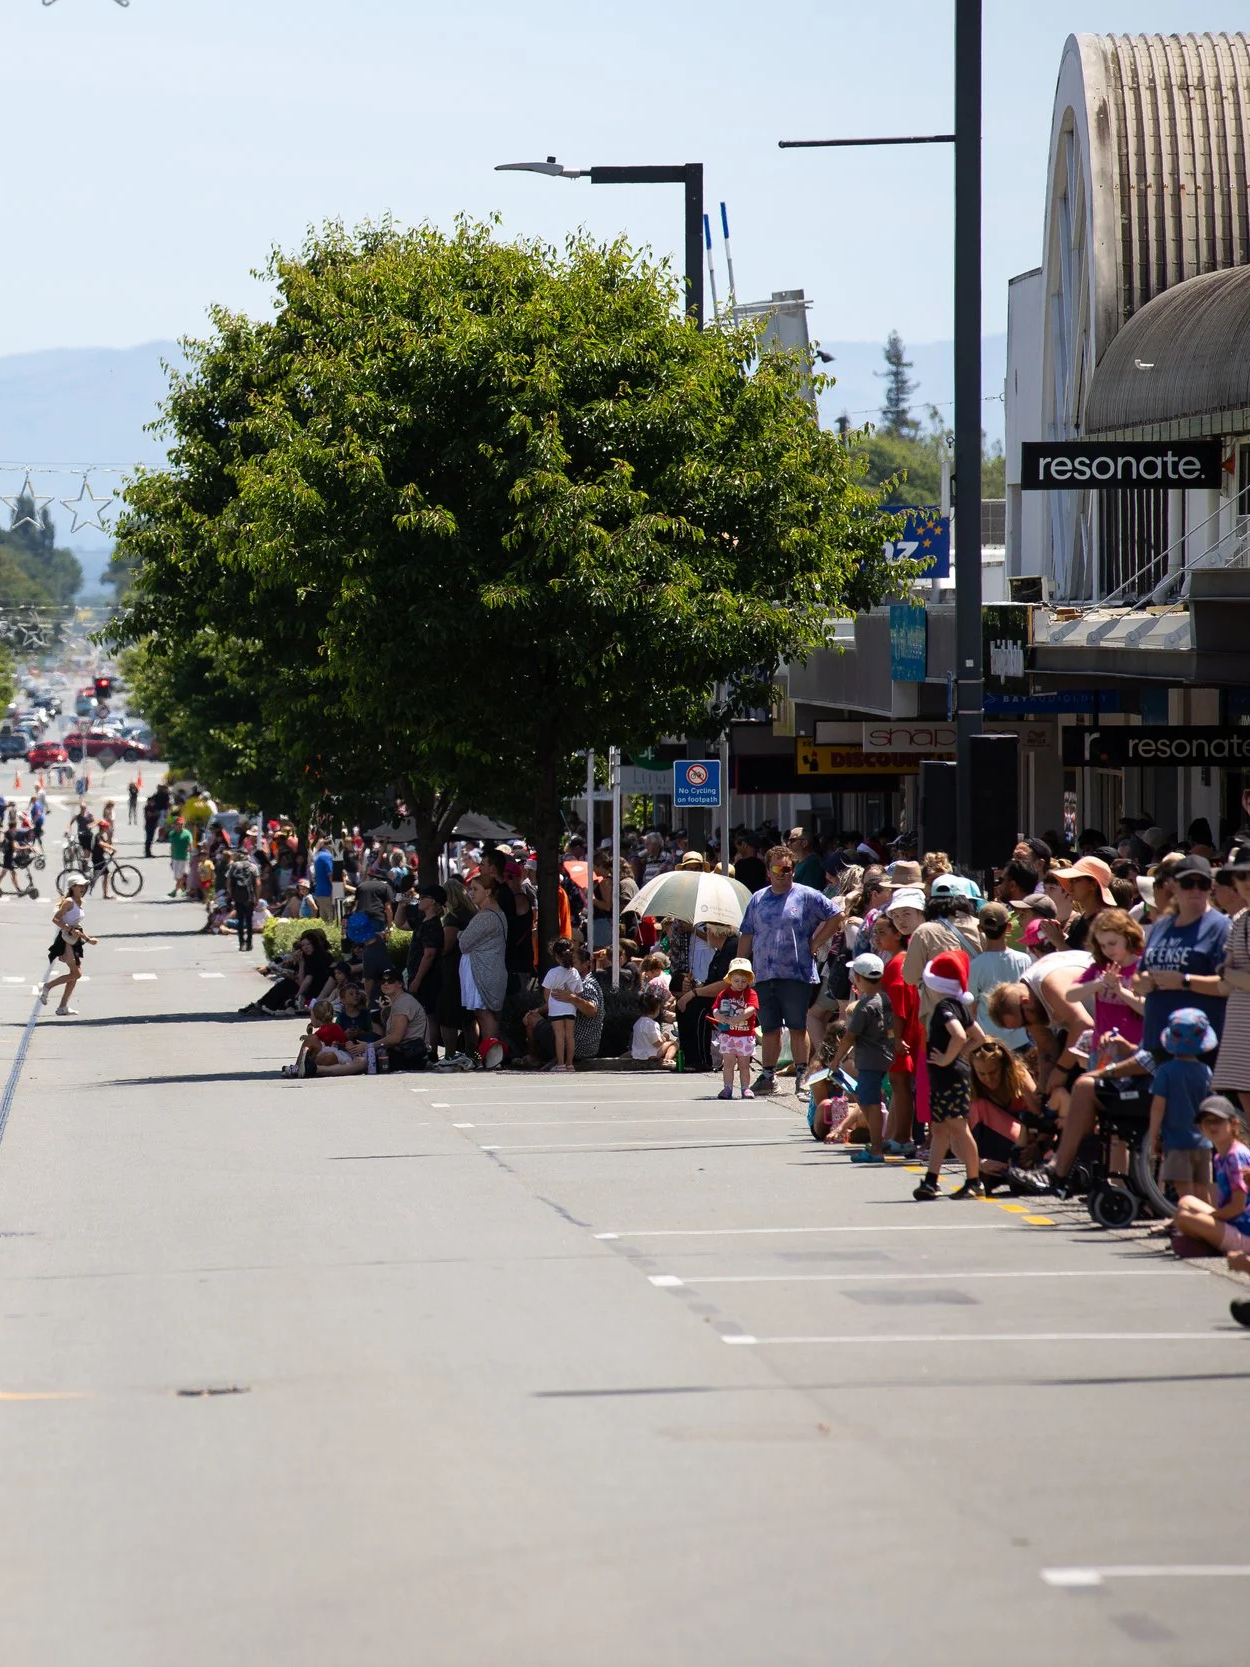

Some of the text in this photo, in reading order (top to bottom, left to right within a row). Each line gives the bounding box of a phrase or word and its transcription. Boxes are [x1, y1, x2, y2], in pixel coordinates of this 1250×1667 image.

[1038, 450, 1206, 480] resonate.
[691, 787, 717, 795] Cycling
[688, 796, 718, 804] footpath
